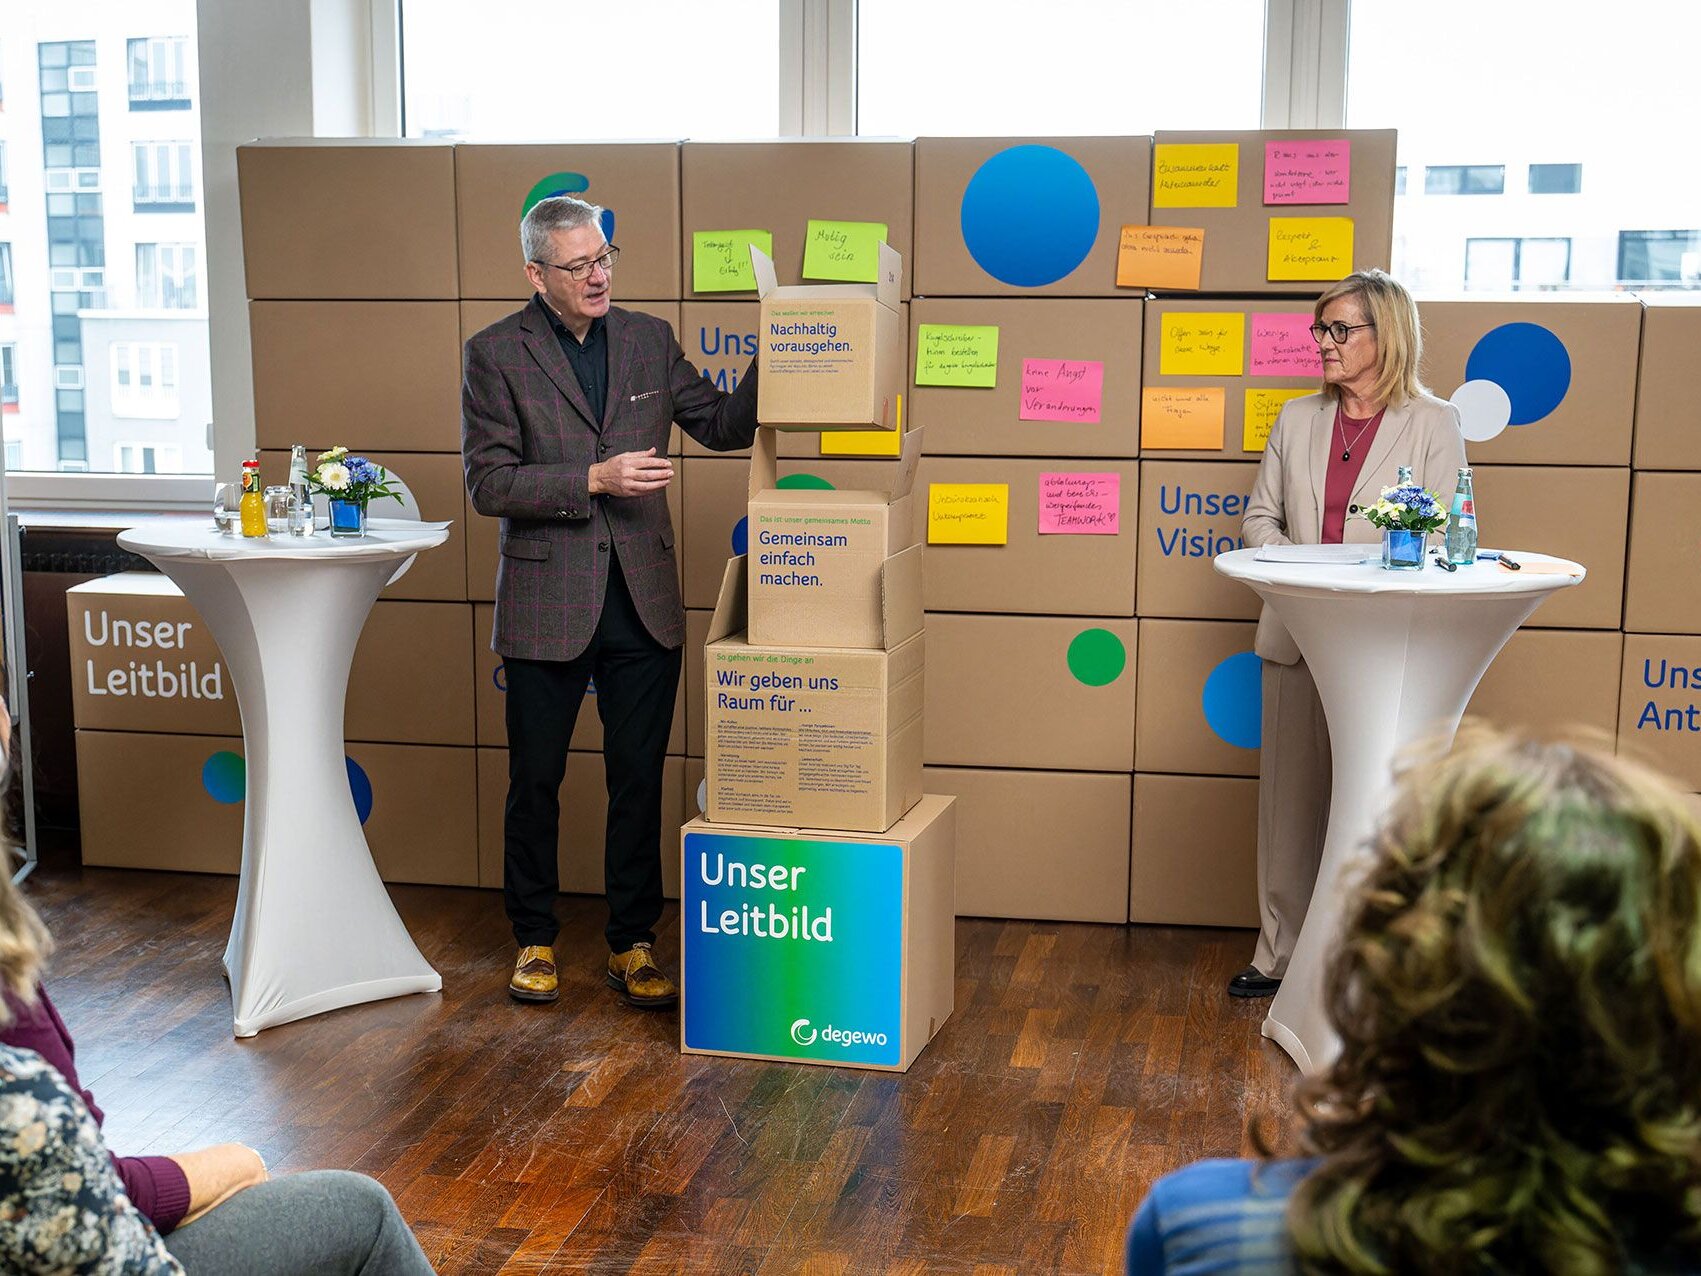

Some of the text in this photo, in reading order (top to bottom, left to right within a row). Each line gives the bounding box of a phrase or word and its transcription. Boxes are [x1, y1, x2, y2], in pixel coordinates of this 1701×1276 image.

[814, 229, 847, 249] Mutig
[828, 249, 855, 261] sein
[770, 322, 838, 338] Nachhaltig
[701, 327, 758, 356] Uns
[770, 339, 854, 355] vorausgehen.
[1056, 362, 1087, 384] Angst
[760, 515, 871, 526] Das ist unser gemeinsames Motto
[760, 530, 848, 546] Gemeinsam
[1156, 527, 1244, 557] Visio
[760, 551, 816, 566] einfach
[760, 571, 824, 587] machen.
[84, 610, 193, 649] Unser
[716, 652, 814, 665] So gehen wir die Dinge an
[86, 658, 224, 700] Leitbild
[716, 670, 839, 692] Wir geben uns
[1643, 658, 1701, 690] Uns
[717, 693, 765, 711] Raum
[769, 694, 796, 712] für
[1637, 701, 1701, 732] Ant
[700, 851, 807, 891] Unser
[700, 900, 834, 942] Leitbild
[821, 1023, 888, 1047] degewo
